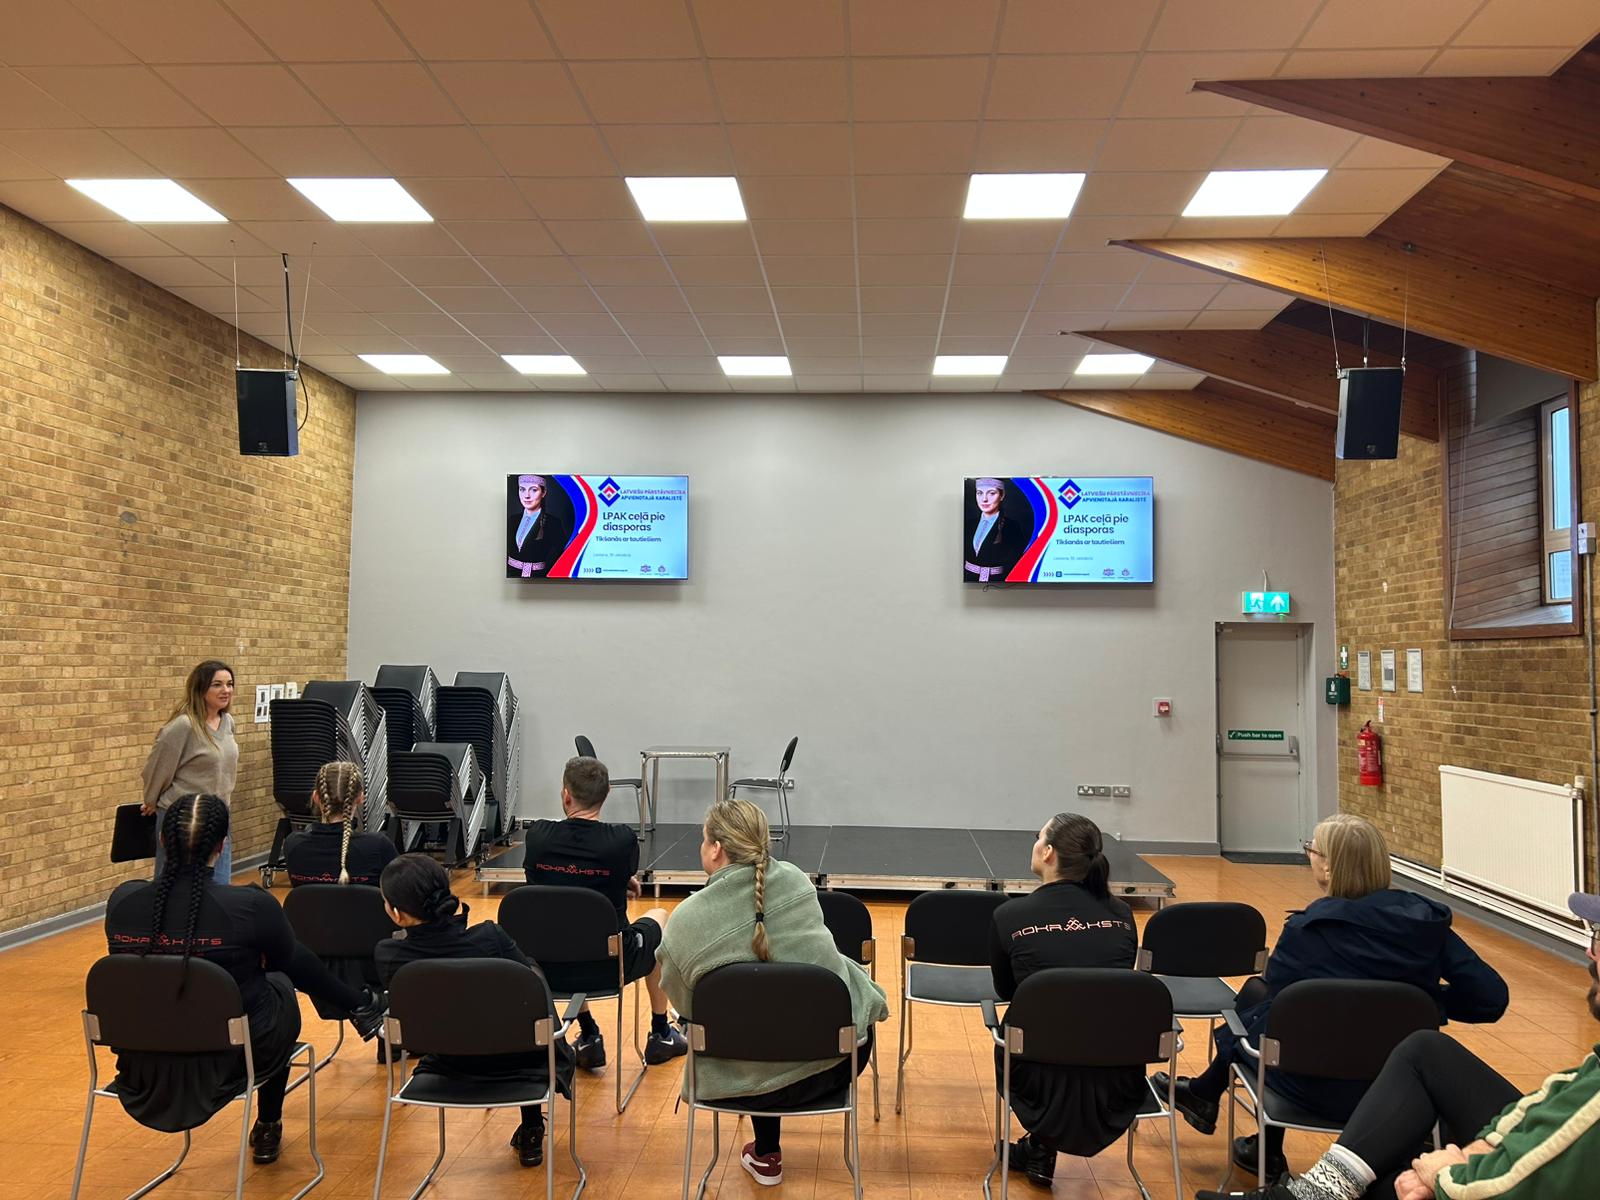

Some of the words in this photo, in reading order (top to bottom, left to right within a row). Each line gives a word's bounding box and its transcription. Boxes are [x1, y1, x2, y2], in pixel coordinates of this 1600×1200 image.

[602, 512, 627, 520] LPAK
[628, 512, 649, 523] ceļā
[650, 512, 666, 523] pie
[1063, 514, 1089, 523] LPAK
[1090, 514, 1112, 525] ceļā
[1113, 514, 1129, 525] pie
[602, 522, 652, 533] diasporas
[1063, 524, 1115, 536] diasporas
